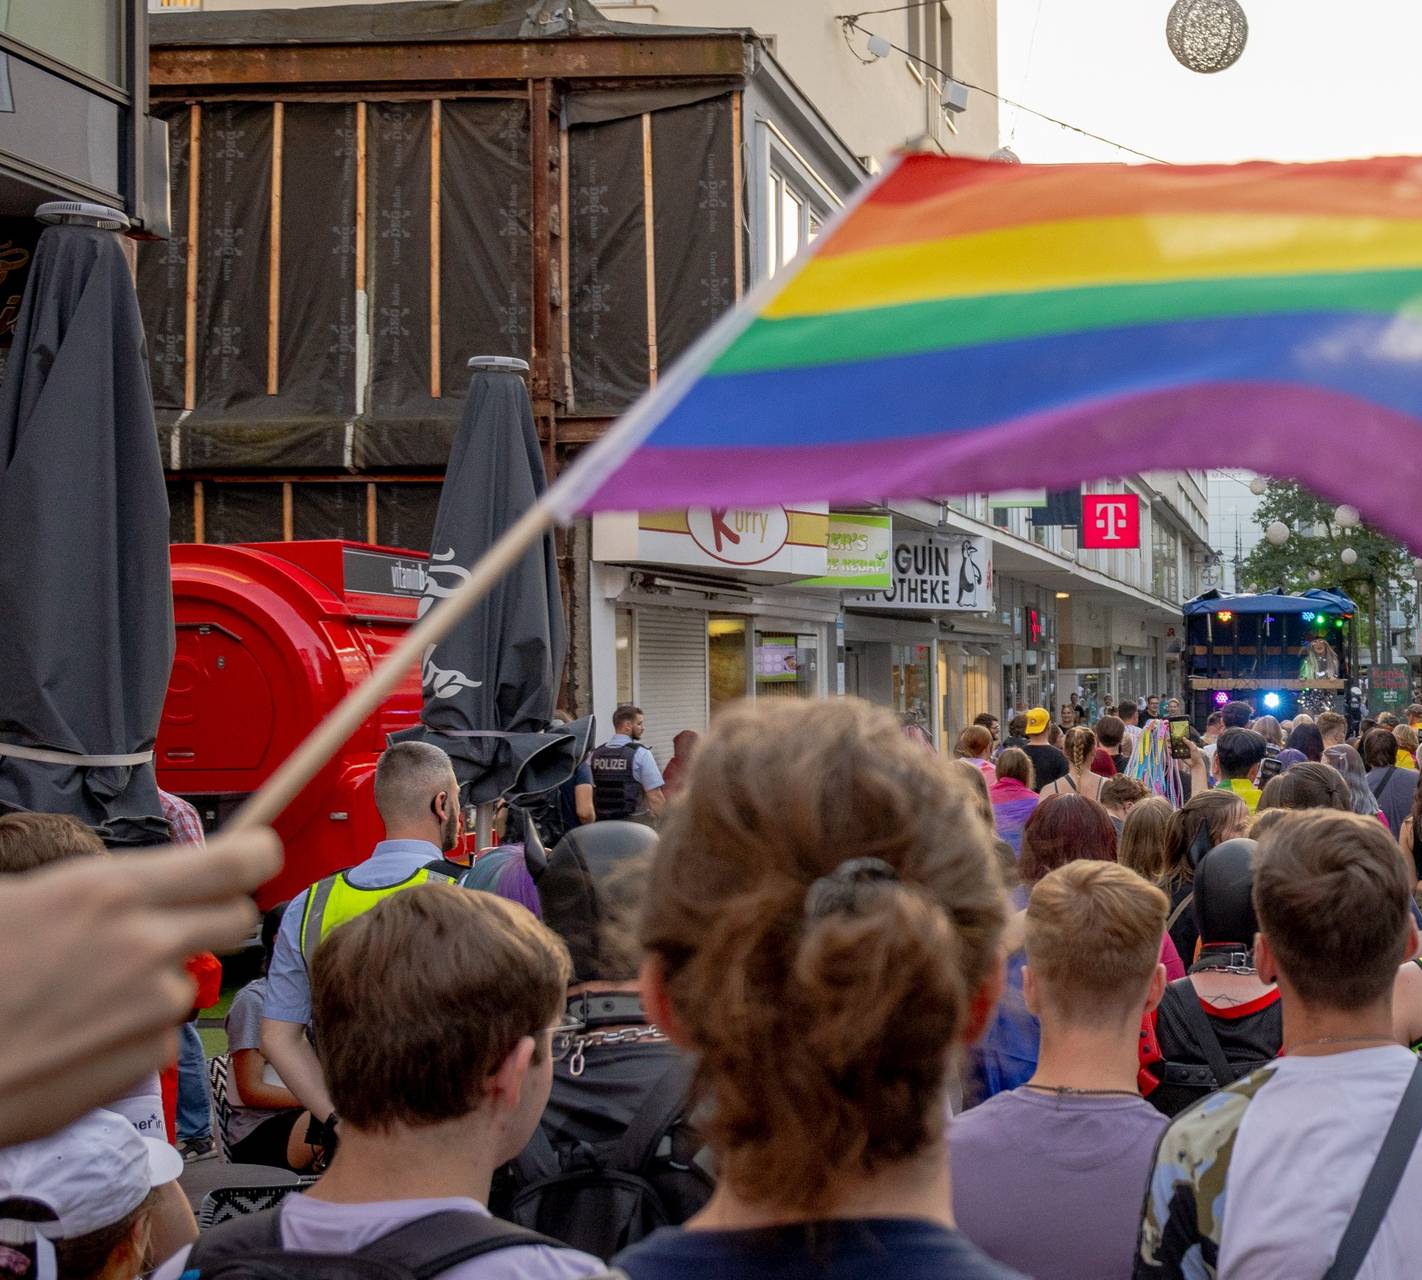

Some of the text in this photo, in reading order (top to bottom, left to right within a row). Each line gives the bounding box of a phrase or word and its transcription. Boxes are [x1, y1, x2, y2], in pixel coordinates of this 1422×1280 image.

[1095, 502, 1127, 540] T
[856, 577, 949, 604] OTHEKE
[593, 759, 627, 770] POLIZEI
